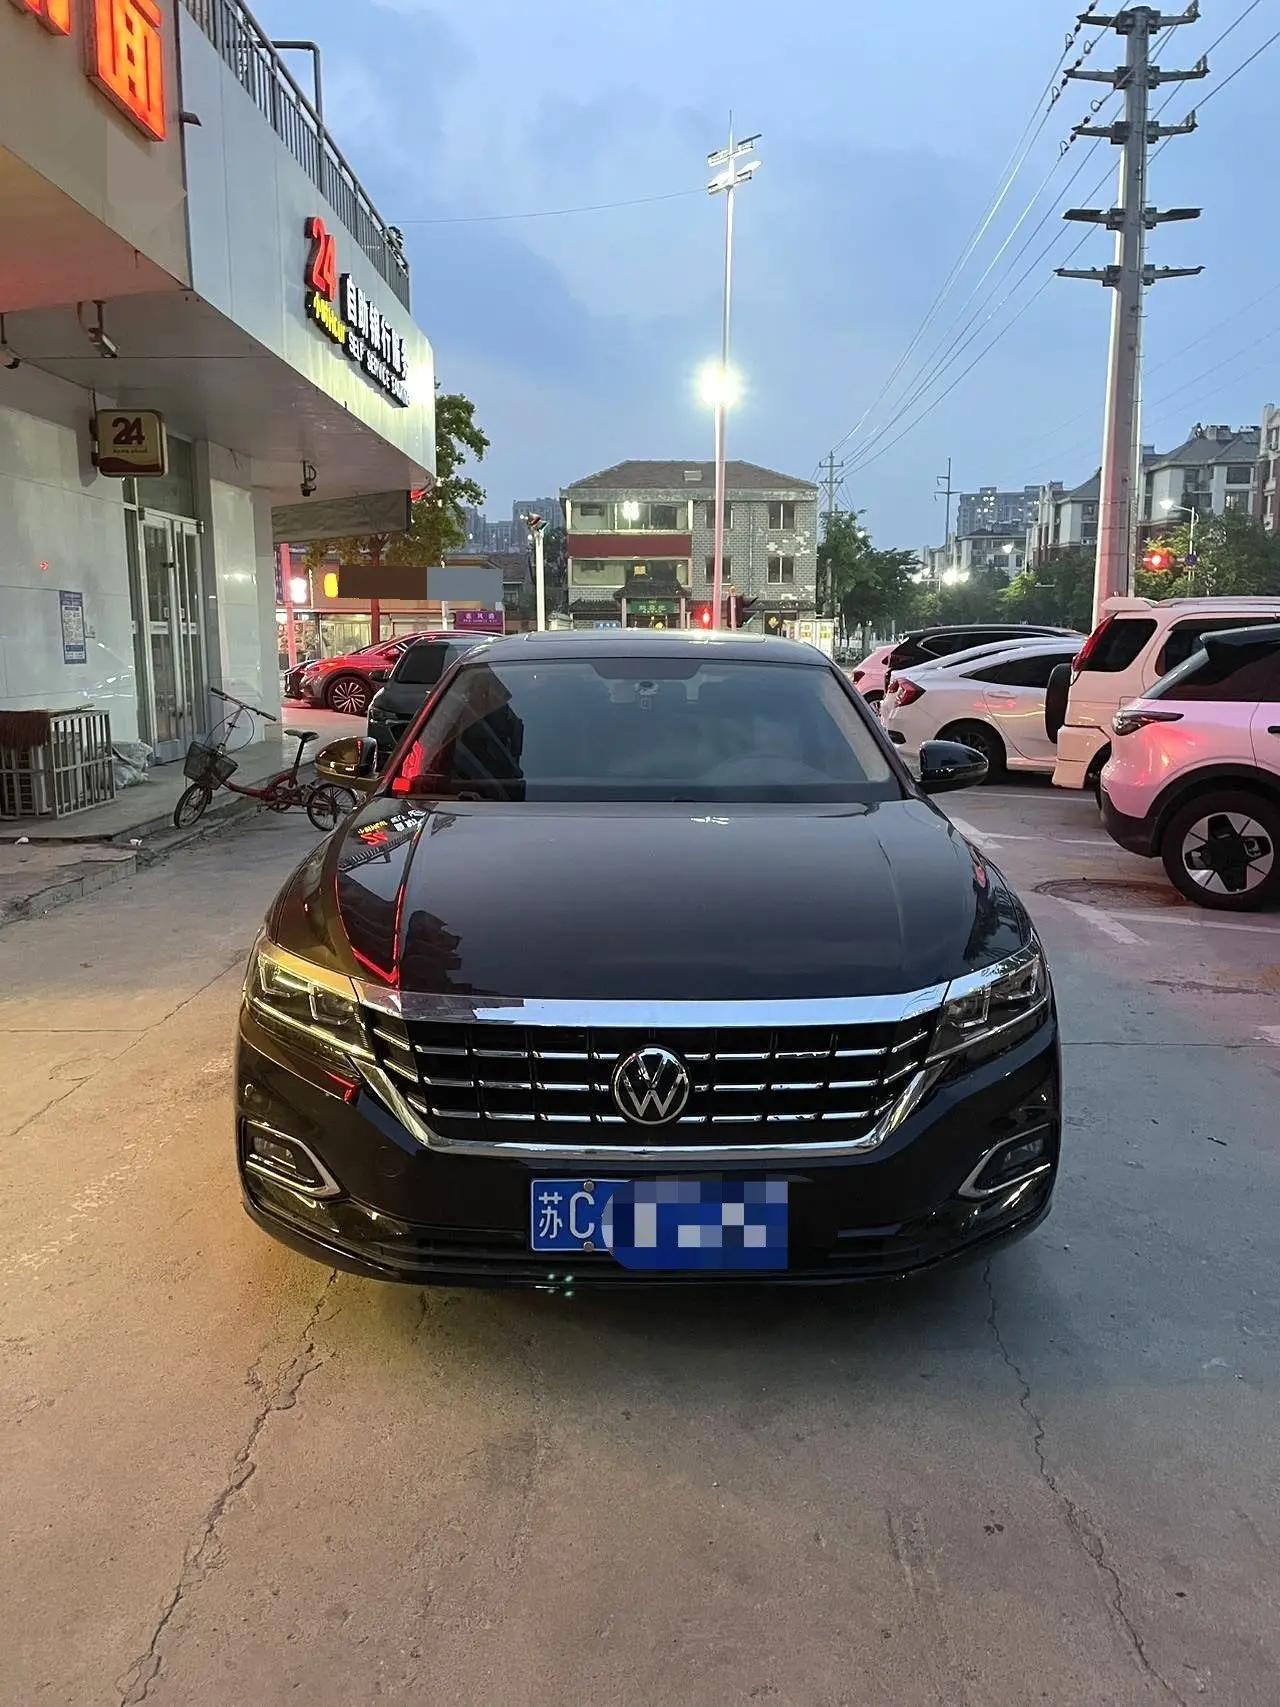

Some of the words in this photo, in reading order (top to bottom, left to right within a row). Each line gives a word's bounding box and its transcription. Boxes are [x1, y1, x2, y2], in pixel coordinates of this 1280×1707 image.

[308, 217, 337, 302] 24
[345, 275, 410, 381] 自助银行服务
[348, 331, 365, 362] SELF
[366, 350, 391, 389] SERVICE
[112, 417, 146, 445] 24
